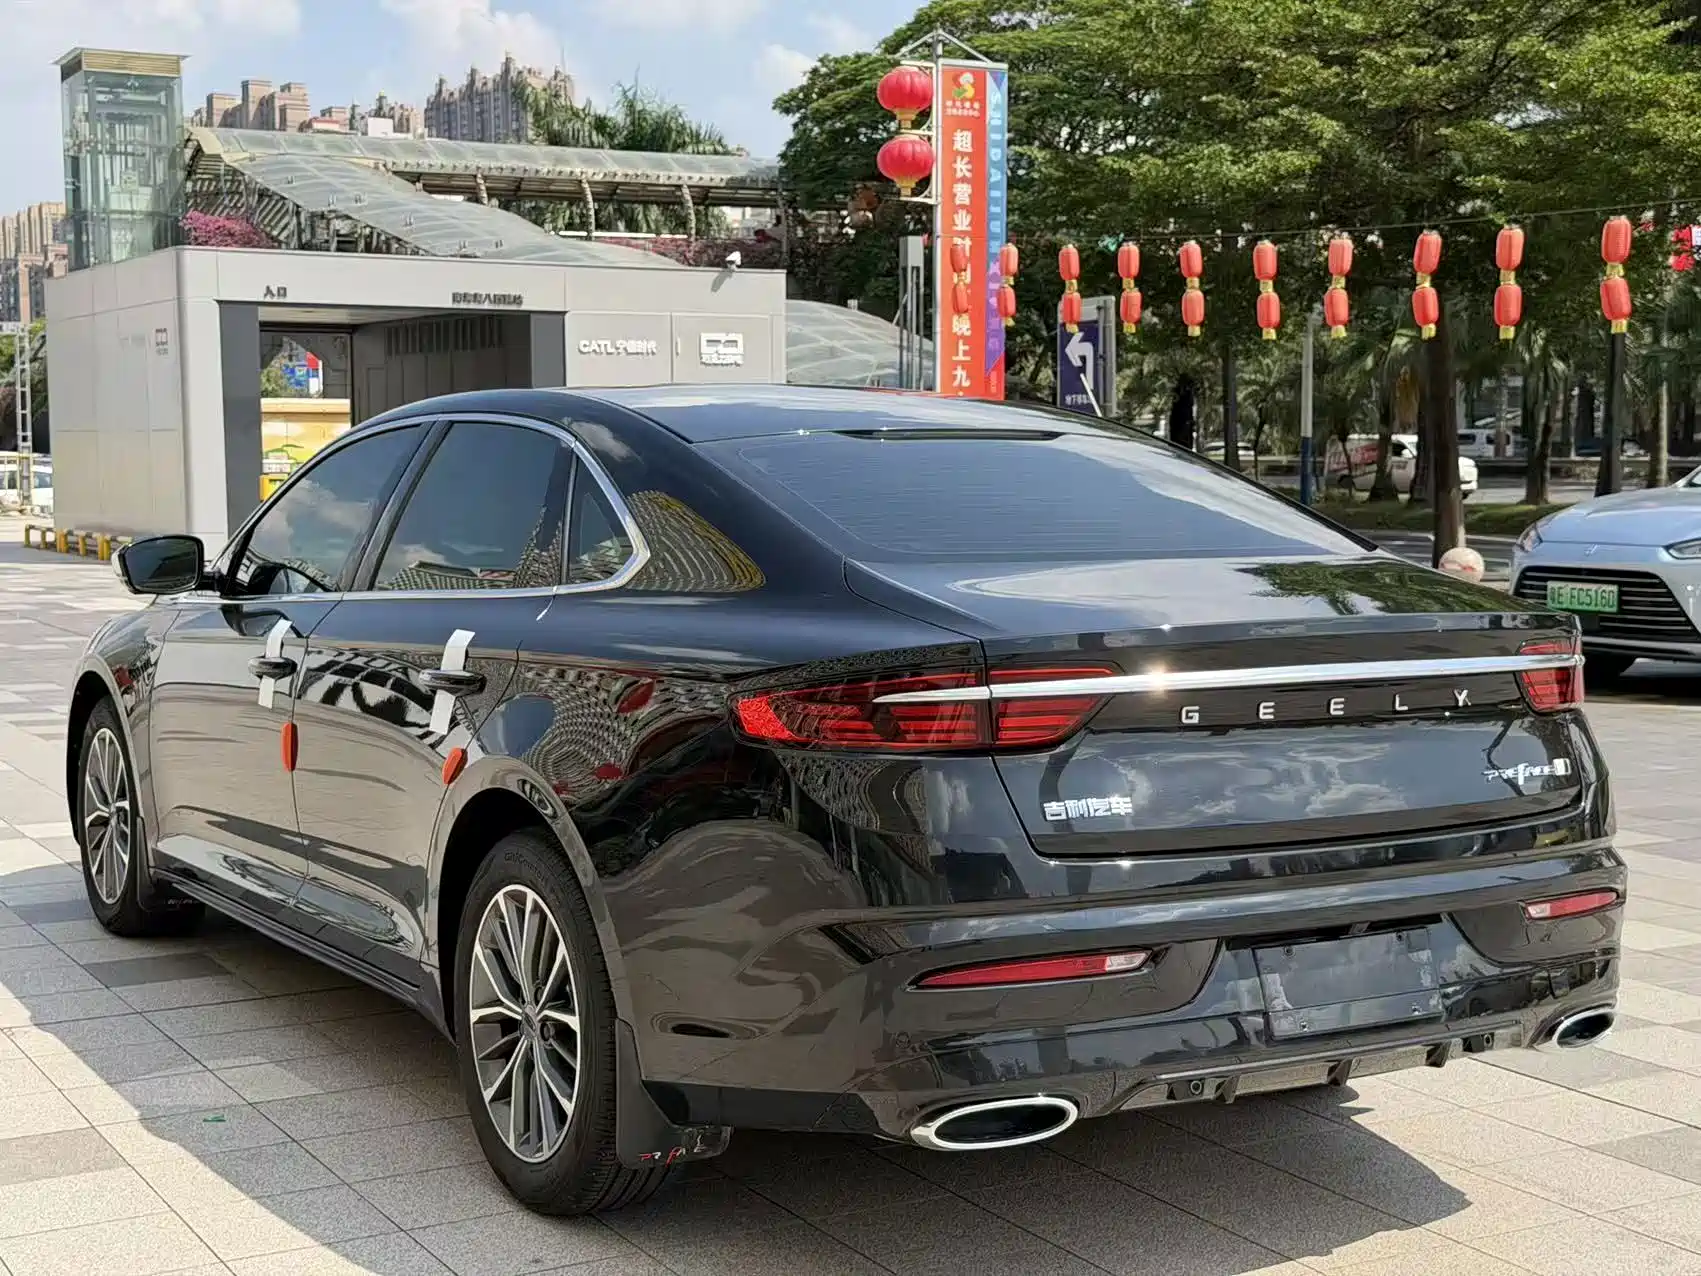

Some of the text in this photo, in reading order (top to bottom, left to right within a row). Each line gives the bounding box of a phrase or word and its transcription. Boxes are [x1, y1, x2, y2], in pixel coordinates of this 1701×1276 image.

[579, 339, 615, 354] CATL
[1180, 689, 1471, 724] GEELY
[1043, 796, 1133, 821] 吉利汽车
